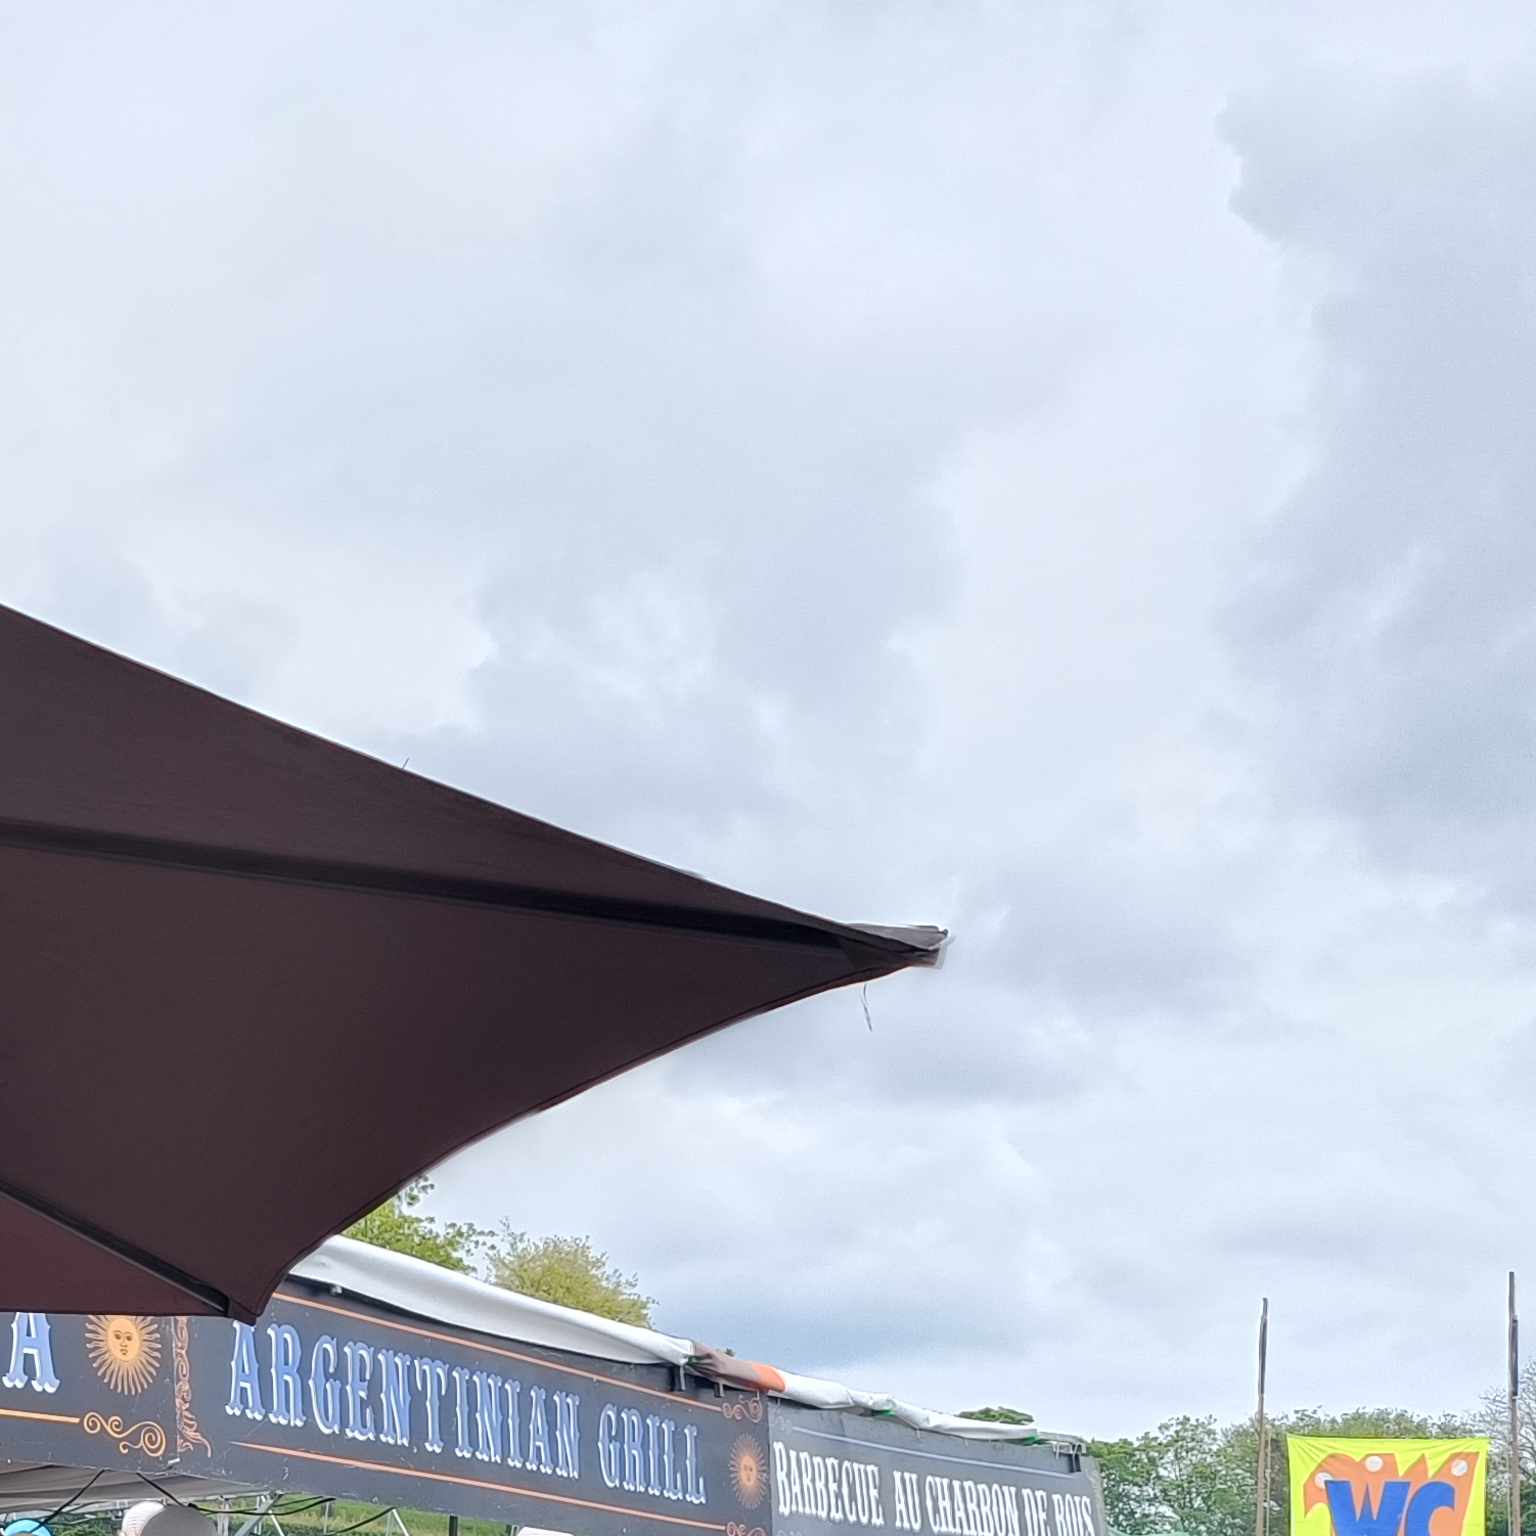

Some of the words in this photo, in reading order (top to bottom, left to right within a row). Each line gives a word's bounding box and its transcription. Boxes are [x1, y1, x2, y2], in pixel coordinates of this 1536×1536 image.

[225, 1320, 582, 1481] ARGENTINIAN
[598, 1402, 706, 1505] GRILL
[772, 1440, 884, 1527] BARBECUE
[892, 1469, 921, 1532] AU
